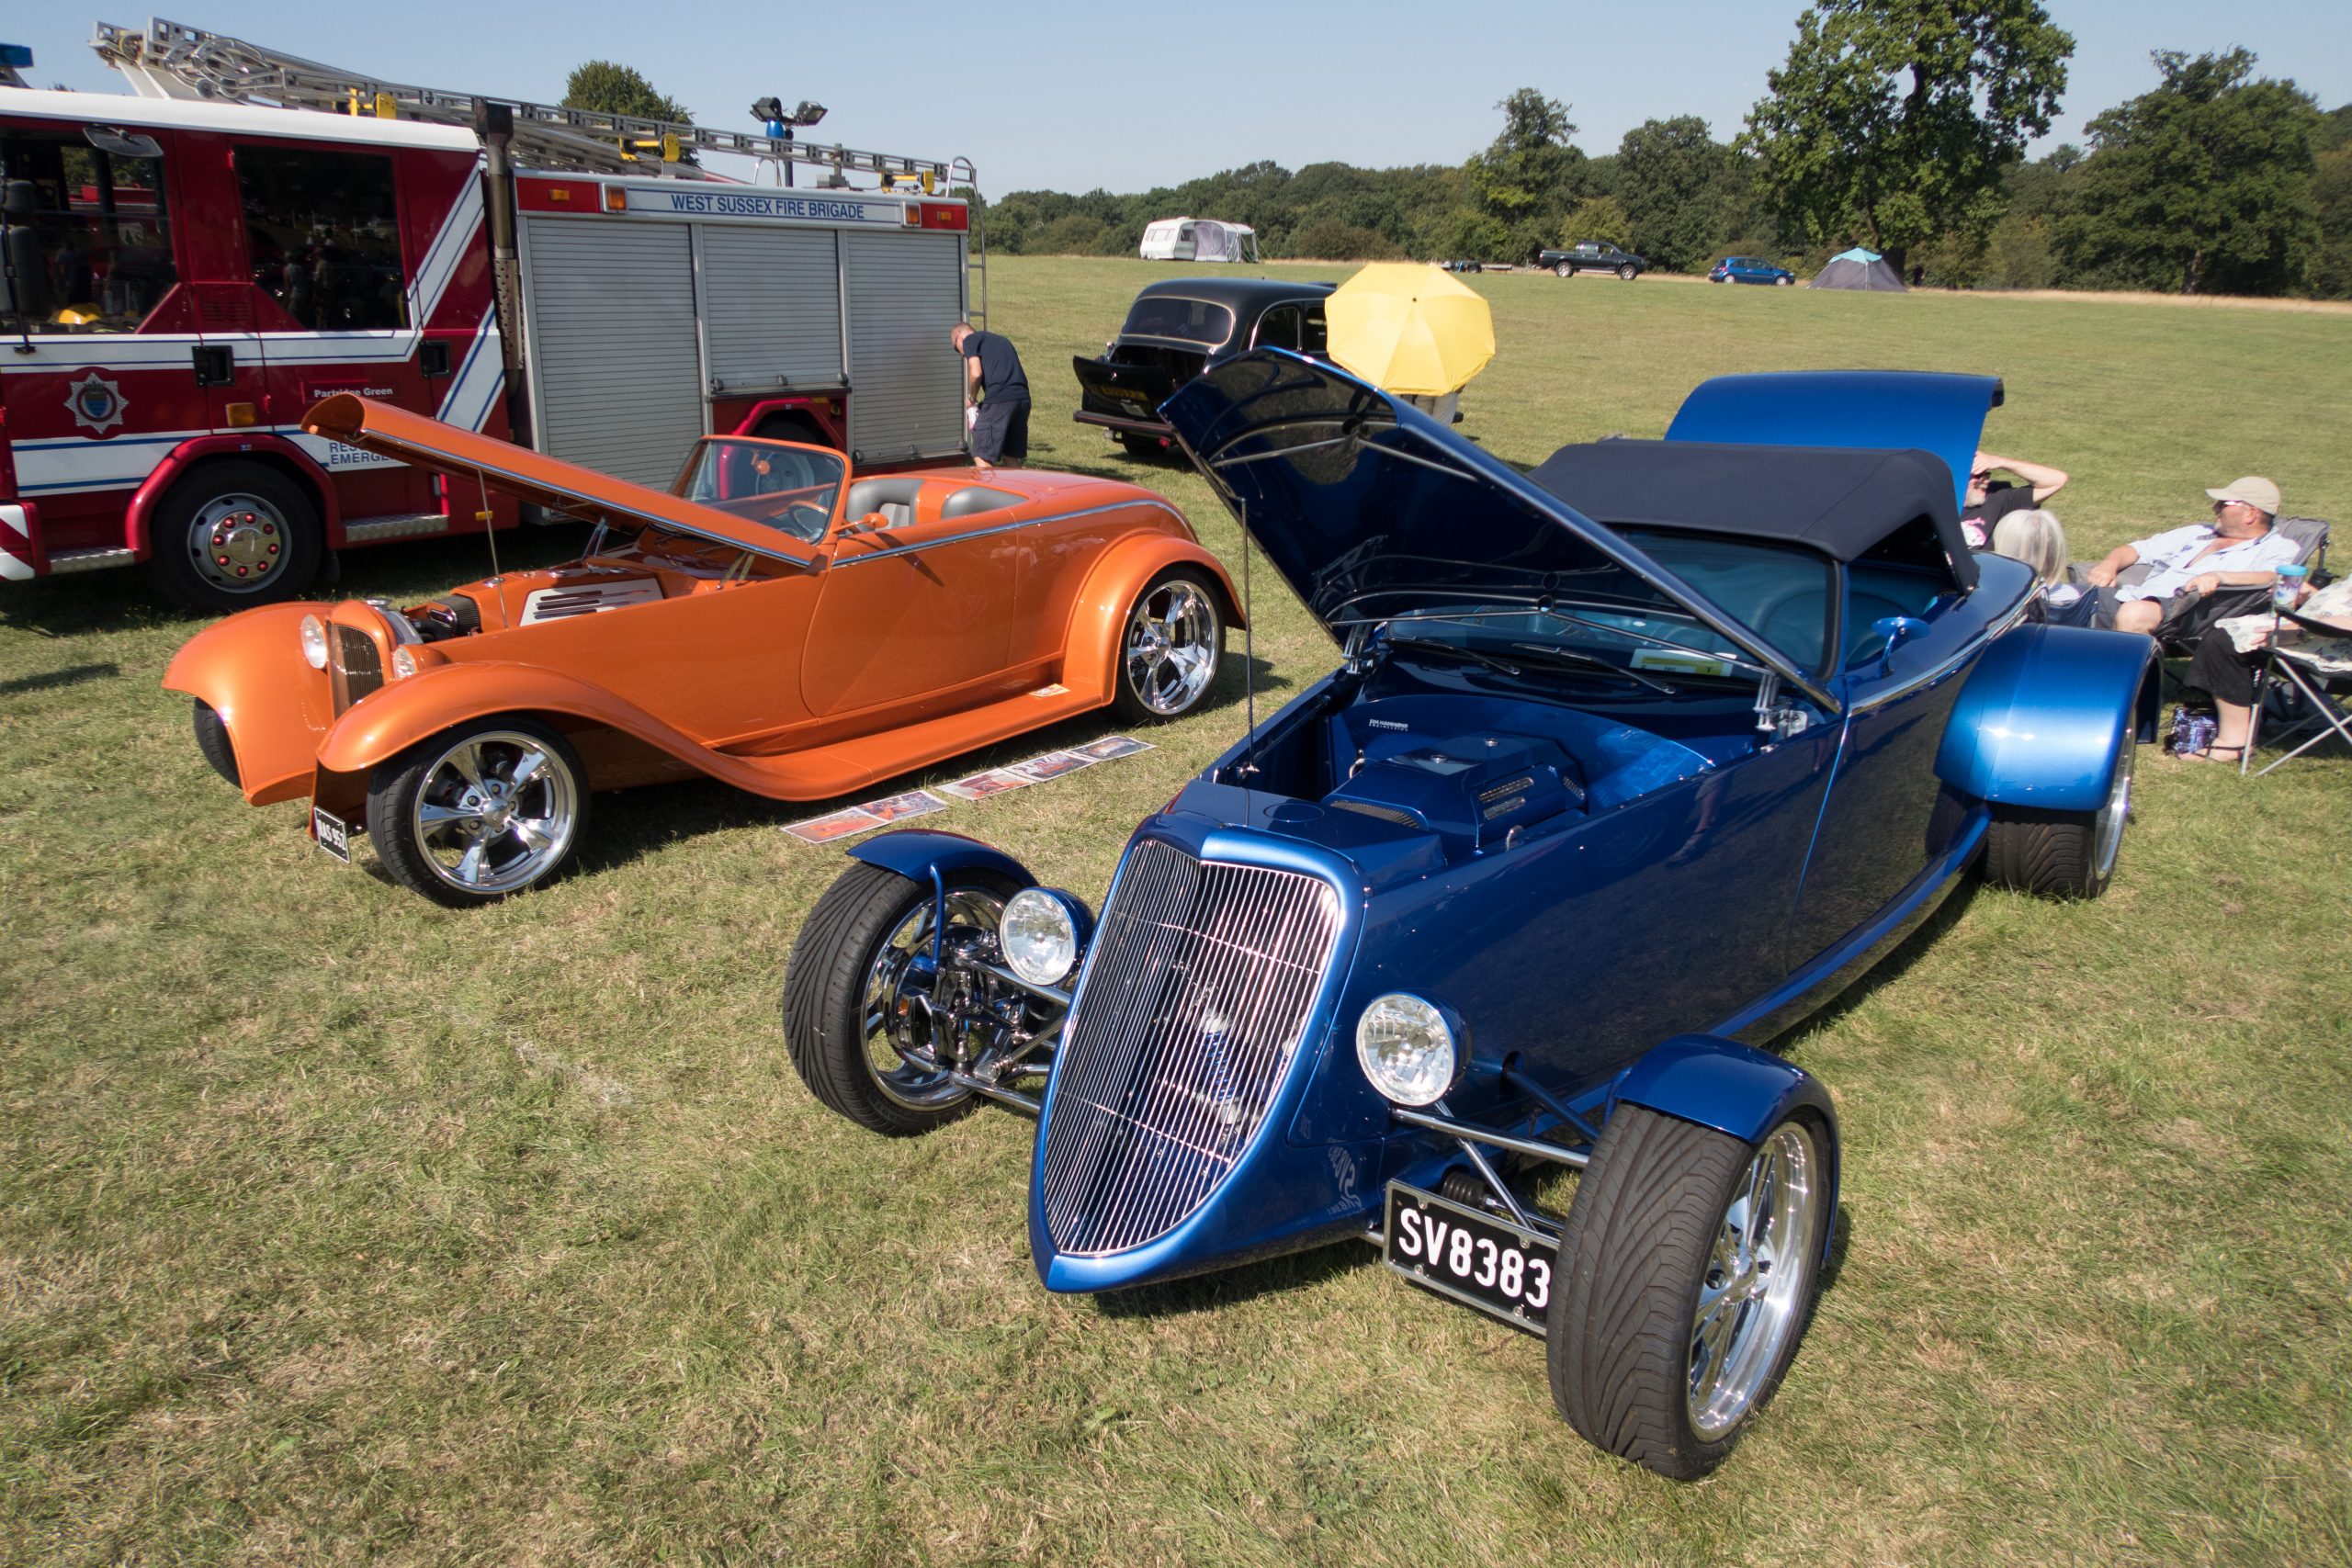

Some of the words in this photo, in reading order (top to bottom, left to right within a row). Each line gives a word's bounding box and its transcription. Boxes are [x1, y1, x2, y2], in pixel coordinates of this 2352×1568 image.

[671, 194, 713, 211] WEST
[717, 197, 772, 214] SUSSEX
[775, 200, 805, 216] FIRE
[808, 202, 865, 220] BRIGADE
[363, 388, 393, 396] Green
[1398, 1208, 1551, 1308] SV8383
